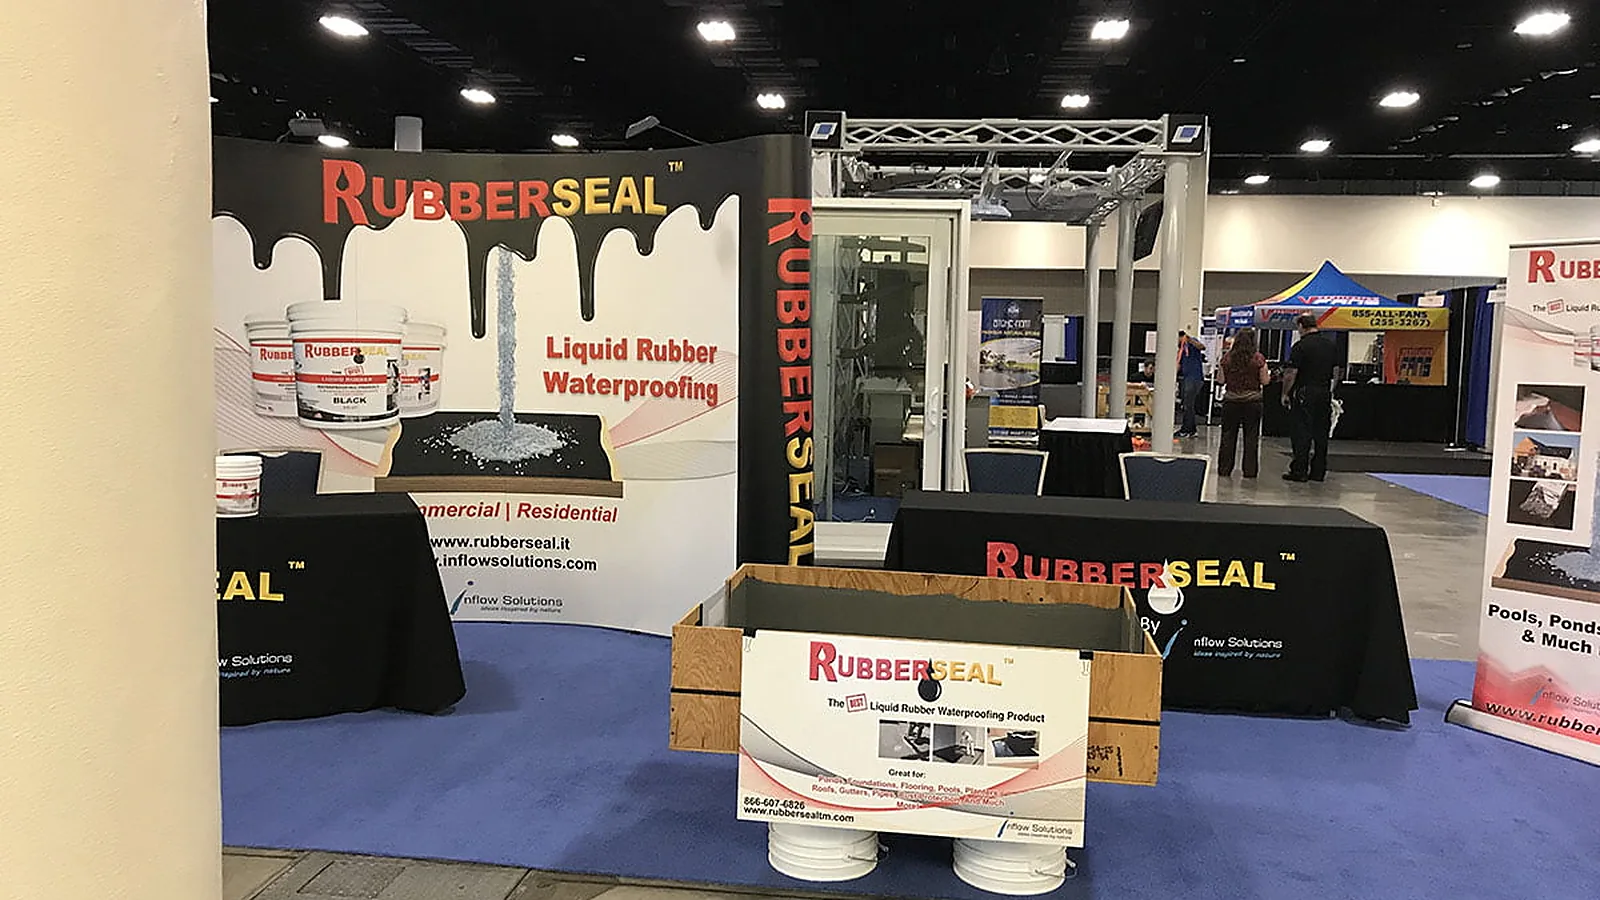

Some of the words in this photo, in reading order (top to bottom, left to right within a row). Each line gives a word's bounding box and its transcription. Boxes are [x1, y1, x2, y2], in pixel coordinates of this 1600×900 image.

[322, 159, 668, 225] RUBBERSEAL
[546, 336, 628, 365] Liquid
[637, 338, 718, 363] Rubber
[543, 371, 718, 407] Waterproofing
[333, 396, 367, 404] BLACK
[517, 502, 618, 523] Residential
[430, 535, 571, 550] www.rubberseal.it
[502, 595, 563, 607] Solutions
[1488, 604, 1542, 628] Pools,
[1140, 617, 1160, 635] By
[1228, 637, 1283, 648] Solutions
[1521, 629, 1535, 643] &
[1542, 633, 1592, 654] Much
[231, 653, 293, 667] Solutions
[809, 641, 1002, 686] RUBBERSEAL
[828, 697, 845, 709] The
[870, 702, 899, 714] Liquid
[901, 703, 936, 716] Rubber
[938, 706, 1005, 722] Waterproofing
[1007, 712, 1046, 723] Product
[888, 768, 910, 778] Great
[744, 797, 806, 810] 866-607-6826
[744, 806, 855, 822] www.rubbersealtm.com
[1032, 823, 1074, 835] Solutions
